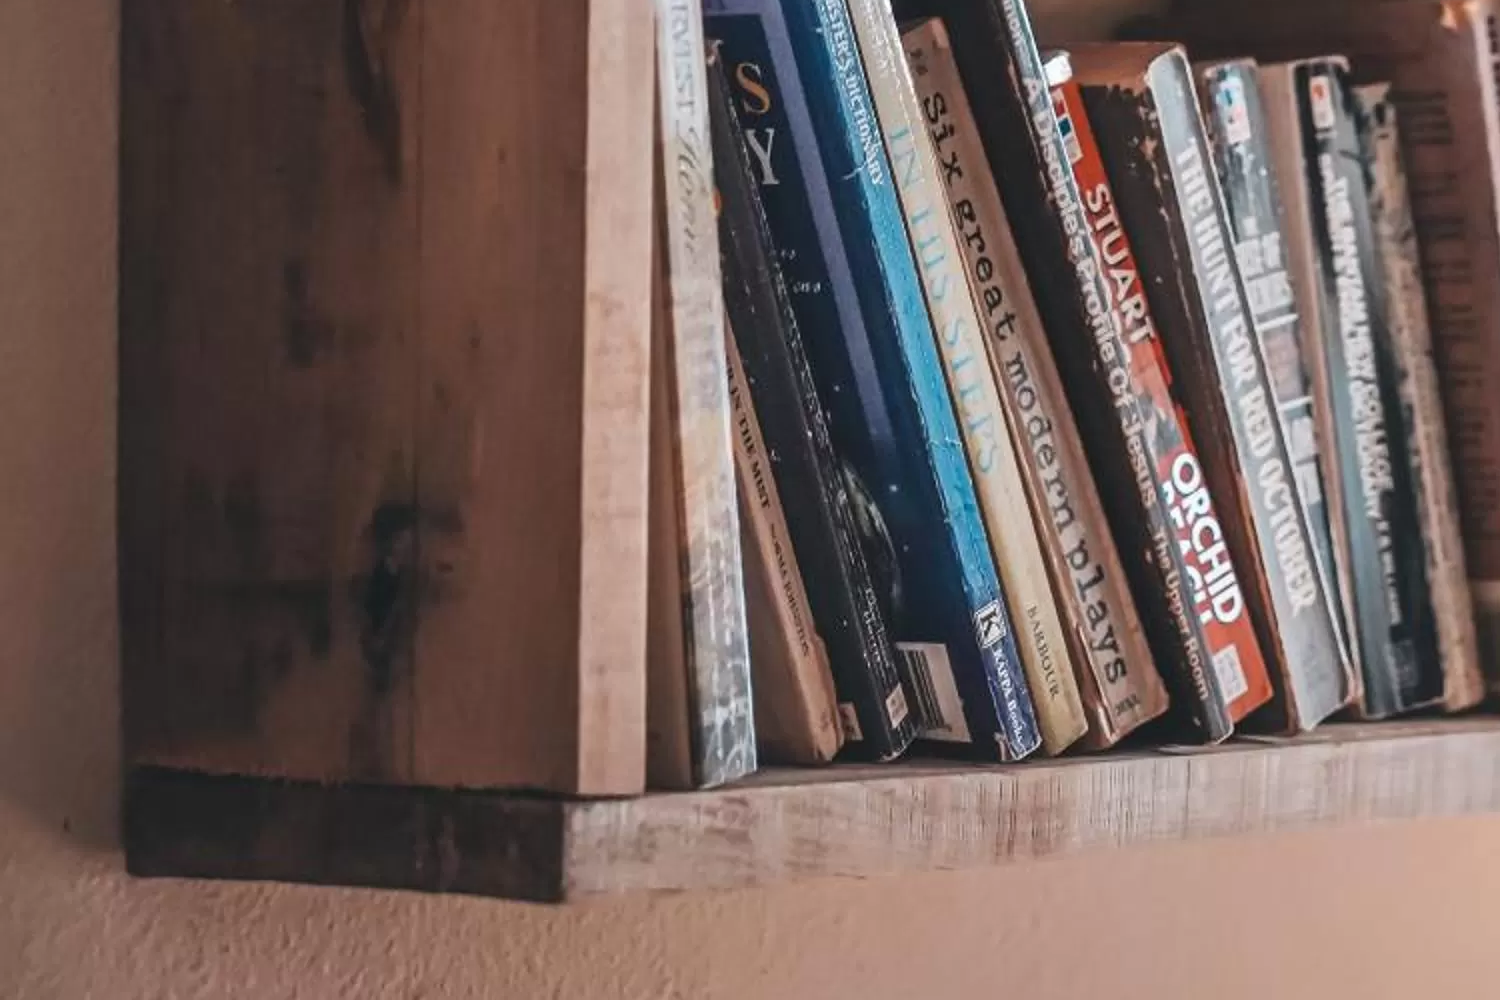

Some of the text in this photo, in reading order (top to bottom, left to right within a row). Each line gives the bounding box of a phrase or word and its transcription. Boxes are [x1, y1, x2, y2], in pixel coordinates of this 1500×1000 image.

[846, 73, 884, 187] DICTIONARY
[1176, 140, 1214, 217] THE
[1022, 77, 1158, 510] A Disciple's Profile Of Jesus
[1087, 183, 1153, 344] STUART
[1194, 214, 1240, 312] HUNT
[924, 91, 963, 186] Six
[954, 199, 1017, 341] great
[1005, 351, 1075, 528] modern
[1064, 538, 1128, 684] plays
[943, 317, 997, 473] STEPS
[1221, 314, 1257, 389] FOR
[1239, 385, 1275, 458] RED
[1365, 380, 1394, 493] COLLEGE
[750, 459, 771, 511] MIST
[1171, 452, 1243, 624] ORCHID
[1259, 459, 1317, 617] OCTOBER
[1027, 605, 1059, 699] BARBOUR
[1153, 527, 1170, 568] The
[1165, 569, 1190, 626] Upper
[1181, 632, 1208, 700] Room
